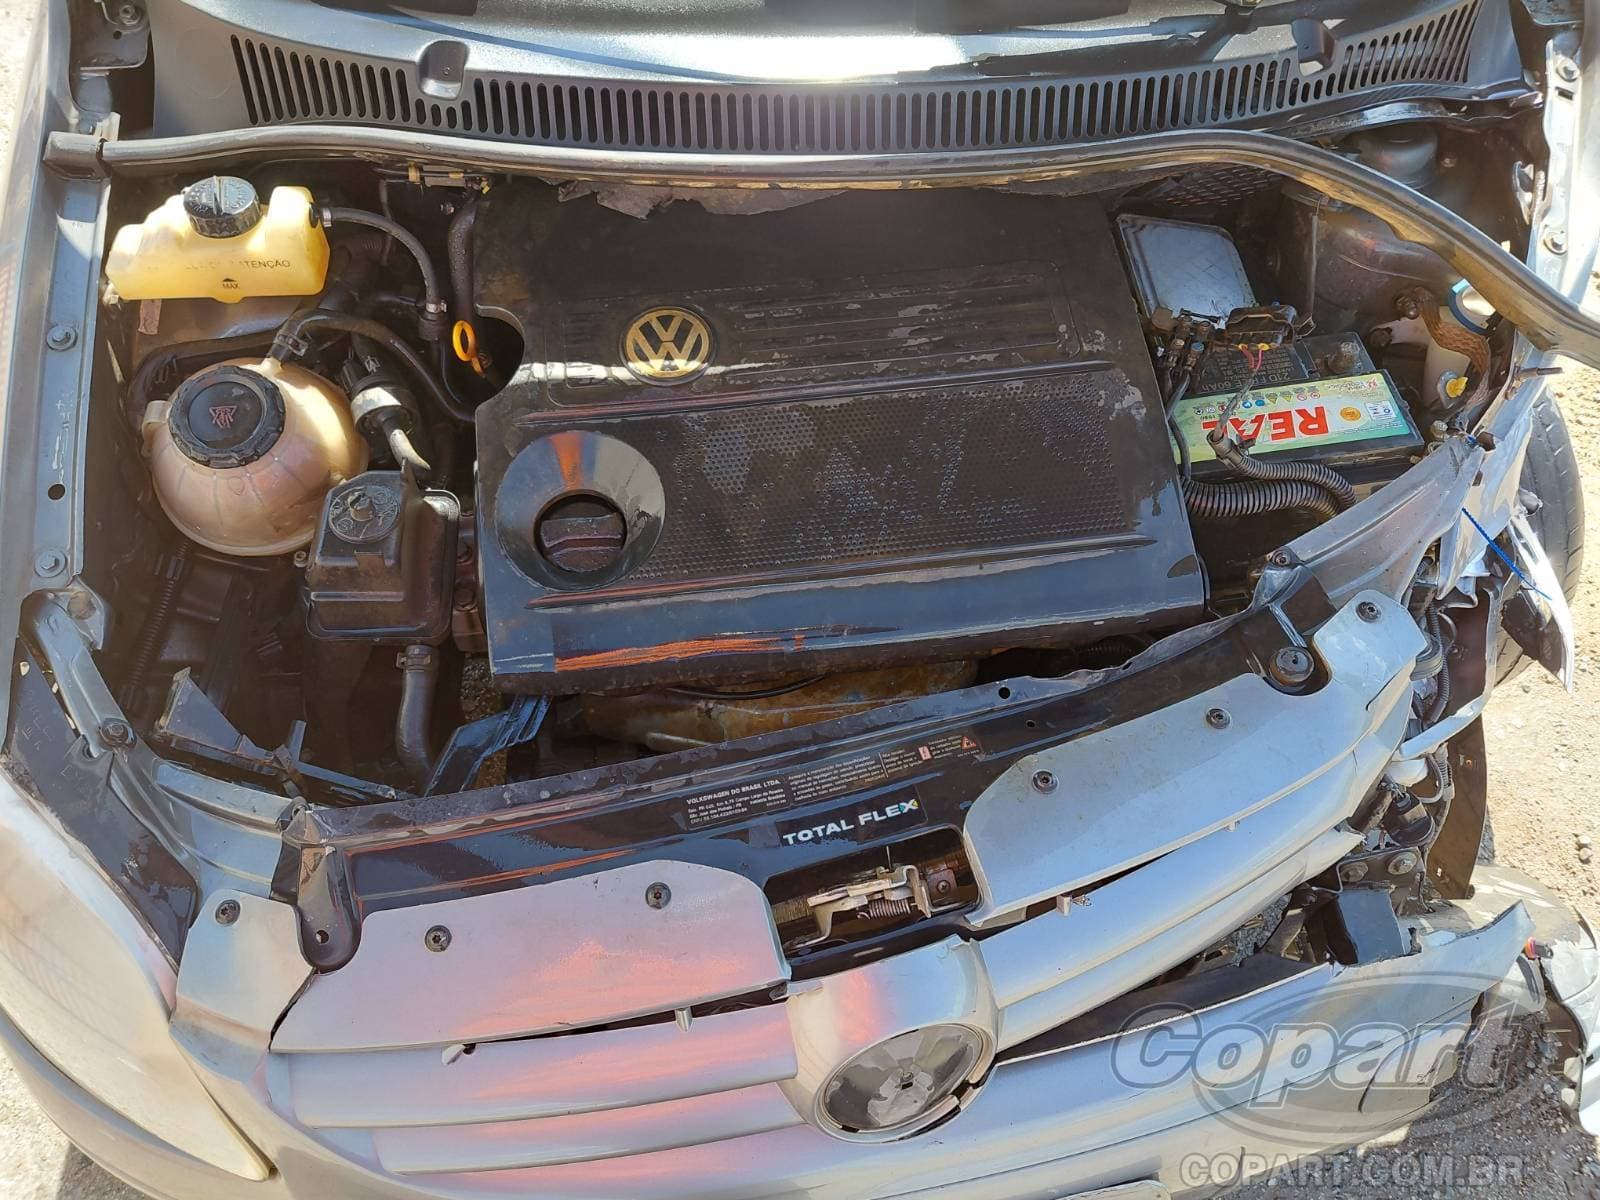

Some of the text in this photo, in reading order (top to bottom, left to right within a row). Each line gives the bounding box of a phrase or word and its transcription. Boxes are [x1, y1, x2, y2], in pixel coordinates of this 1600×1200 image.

[240, 258, 291, 269] TENÇÃO
[222, 282, 239, 290] MAX
[686, 790, 730, 804] VOLKSWAGEN
[731, 788, 740, 796] DO
[741, 783, 762, 793] BRASIL
[782, 798, 919, 846] TOTAL FLEX
